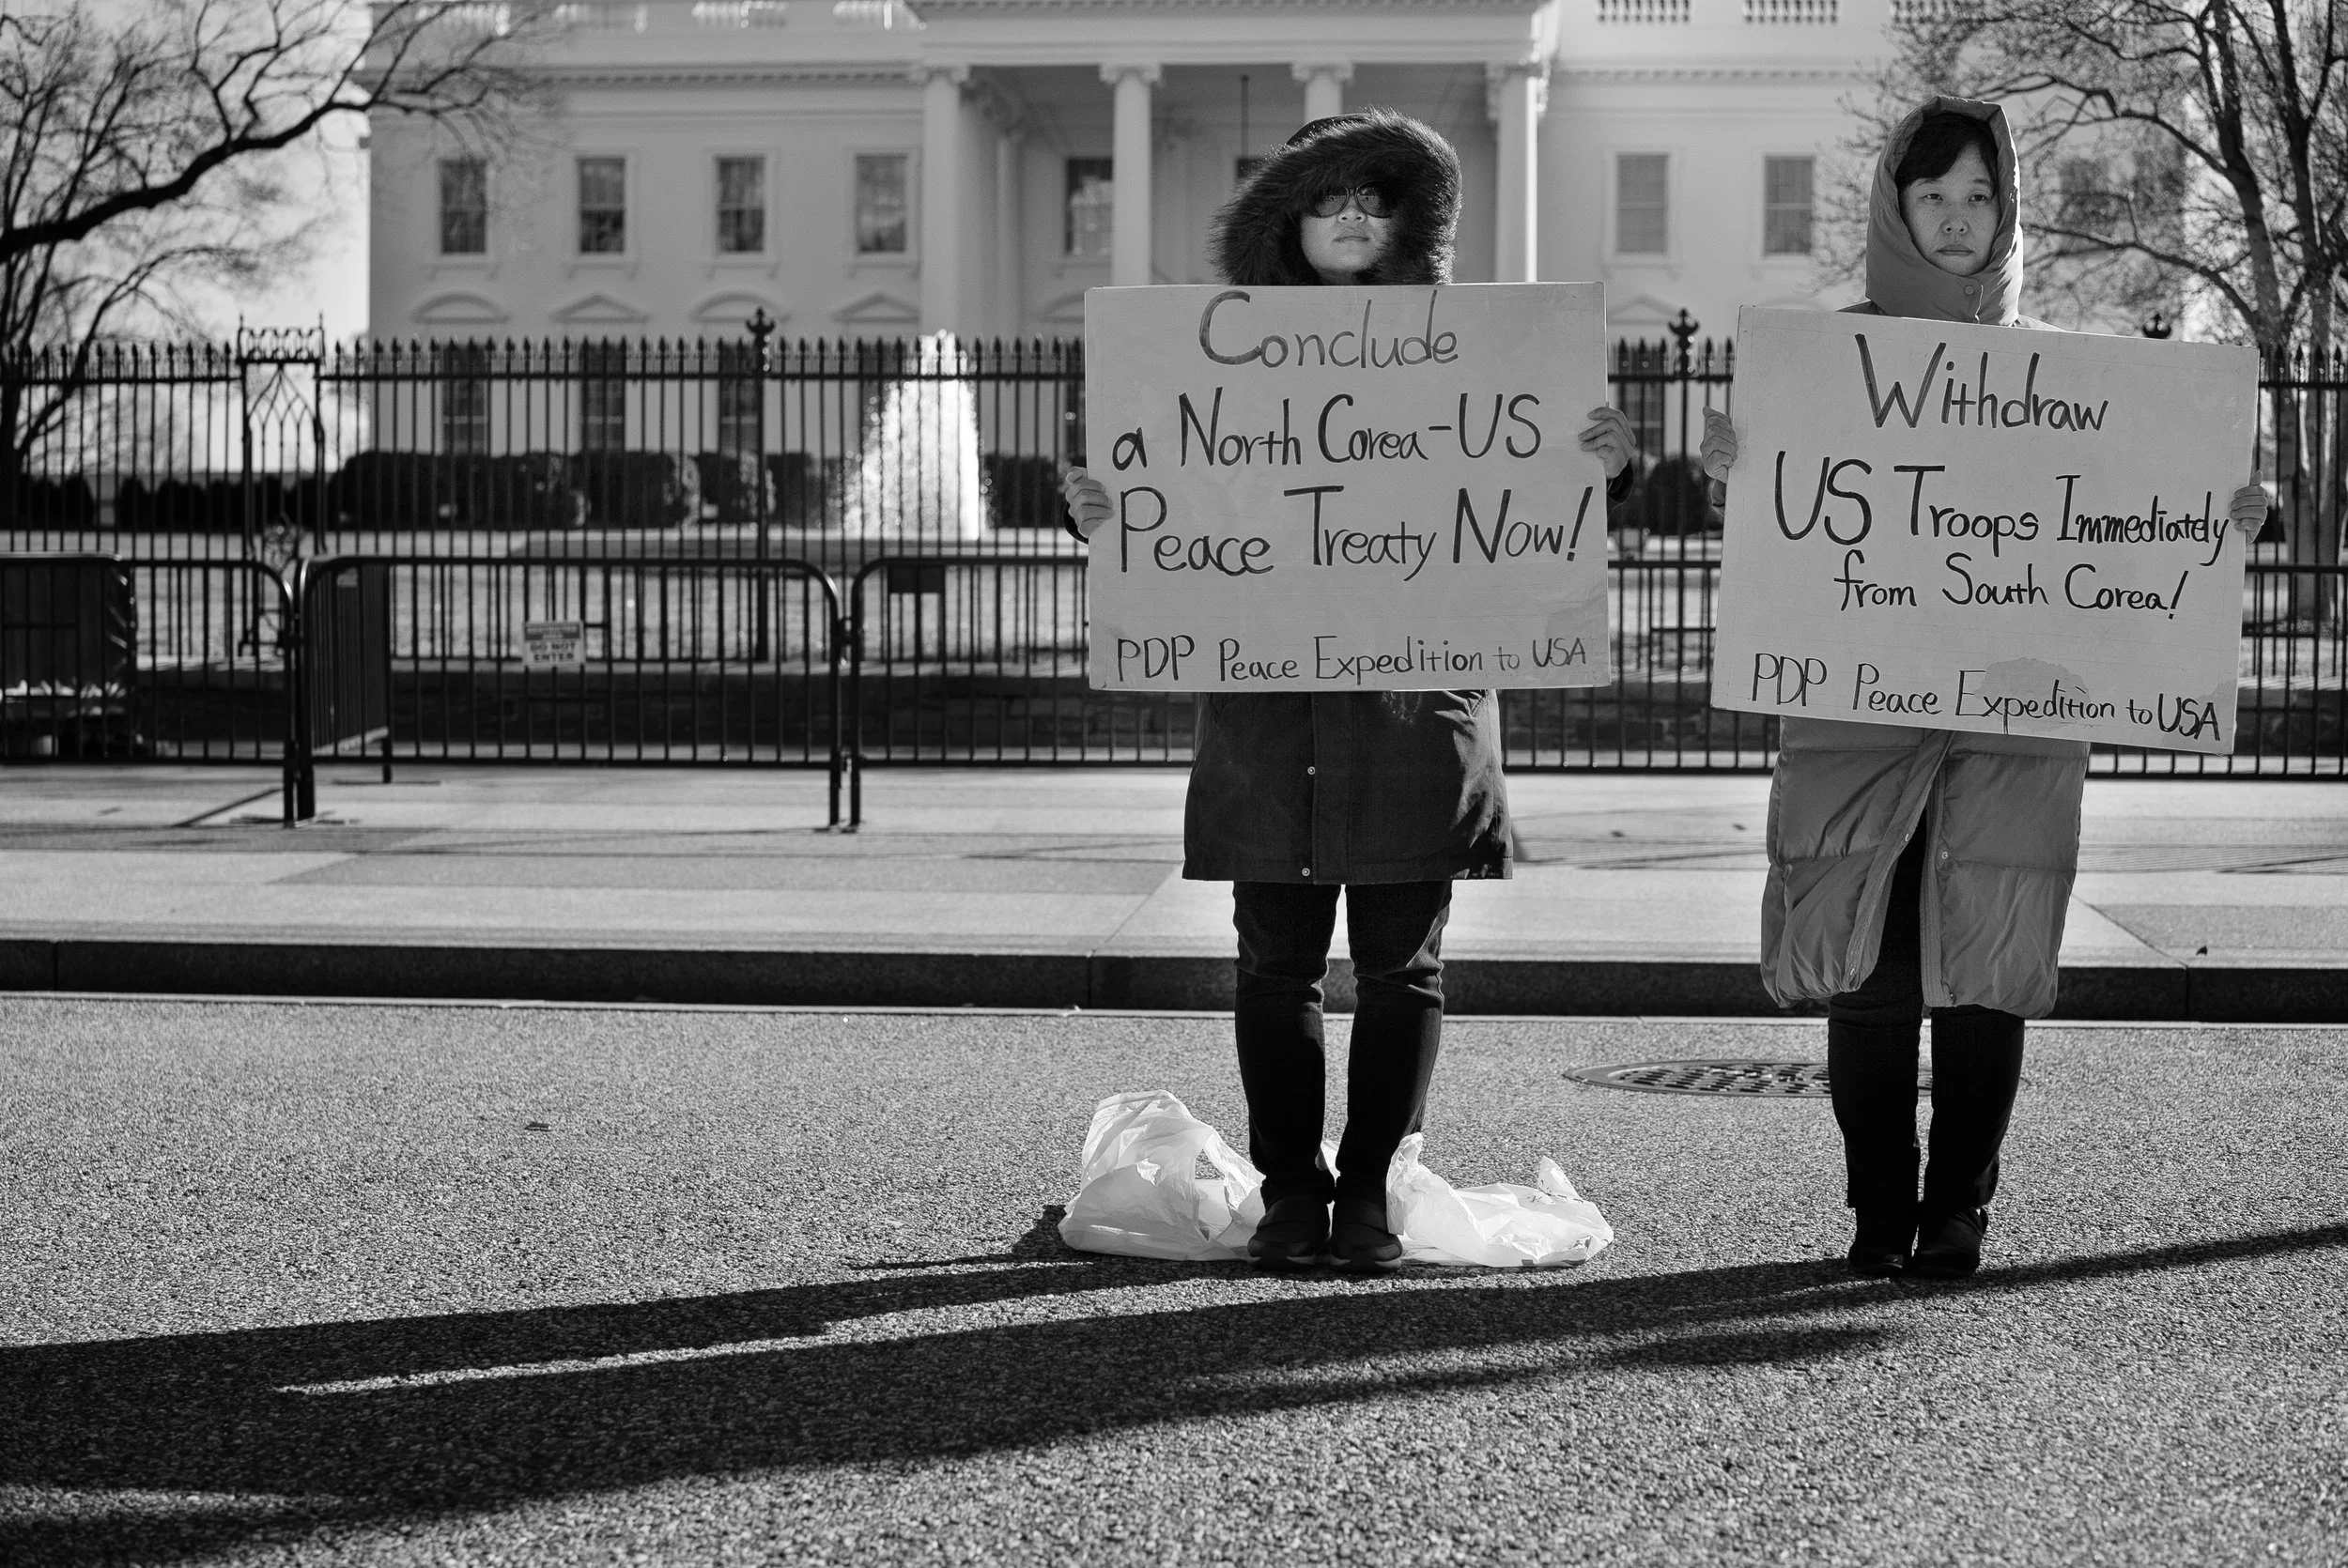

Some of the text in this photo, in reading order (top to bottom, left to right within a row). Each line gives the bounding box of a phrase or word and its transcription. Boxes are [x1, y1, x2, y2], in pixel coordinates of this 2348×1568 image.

[1198, 289, 1459, 369] Conclude
[1855, 333, 2109, 431] Withdraw
[1112, 427, 1147, 469] a
[1179, 386, 1302, 468] North
[1120, 485, 1594, 582] Peace Treaty Now!
[1775, 450, 2229, 566] US Troops Immediately
[1834, 549, 2188, 620] from South Corea!
[1118, 635, 1586, 685] PDP Peace Expedition to USA
[1752, 653, 2221, 740] PDP Peace Expedition to USA
